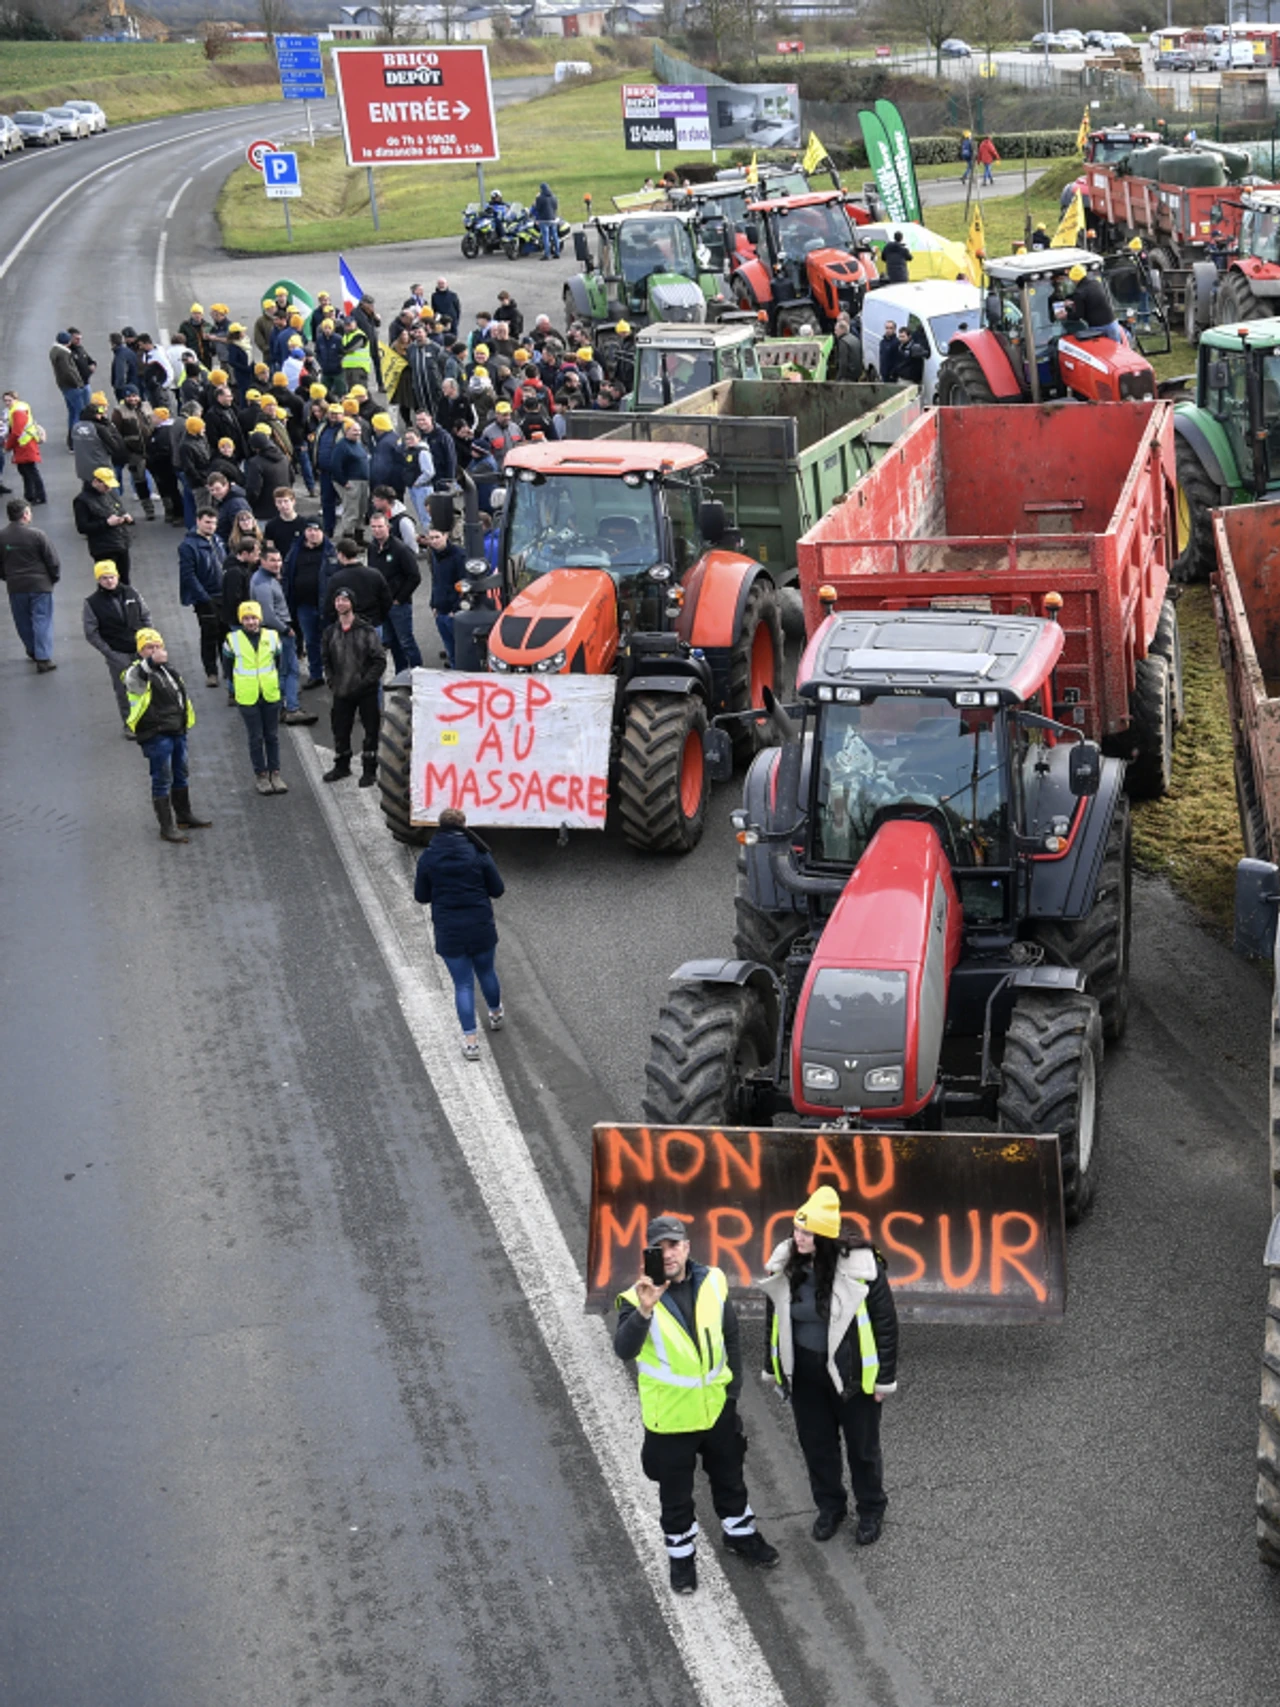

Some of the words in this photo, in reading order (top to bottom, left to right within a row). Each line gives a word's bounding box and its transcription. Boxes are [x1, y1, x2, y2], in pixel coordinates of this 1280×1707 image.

[383, 52, 439, 67] BRICO
[386, 66, 441, 85] DEPÔT
[368, 96, 451, 123] ENTRÉE
[374, 147, 424, 157] dimanche
[271, 159, 288, 180] P
[437, 677, 553, 728] STOP
[475, 722, 535, 763] AU
[424, 761, 611, 818] MASSACRE
[605, 1128, 762, 1189] NON
[807, 1134, 896, 1199] AU
